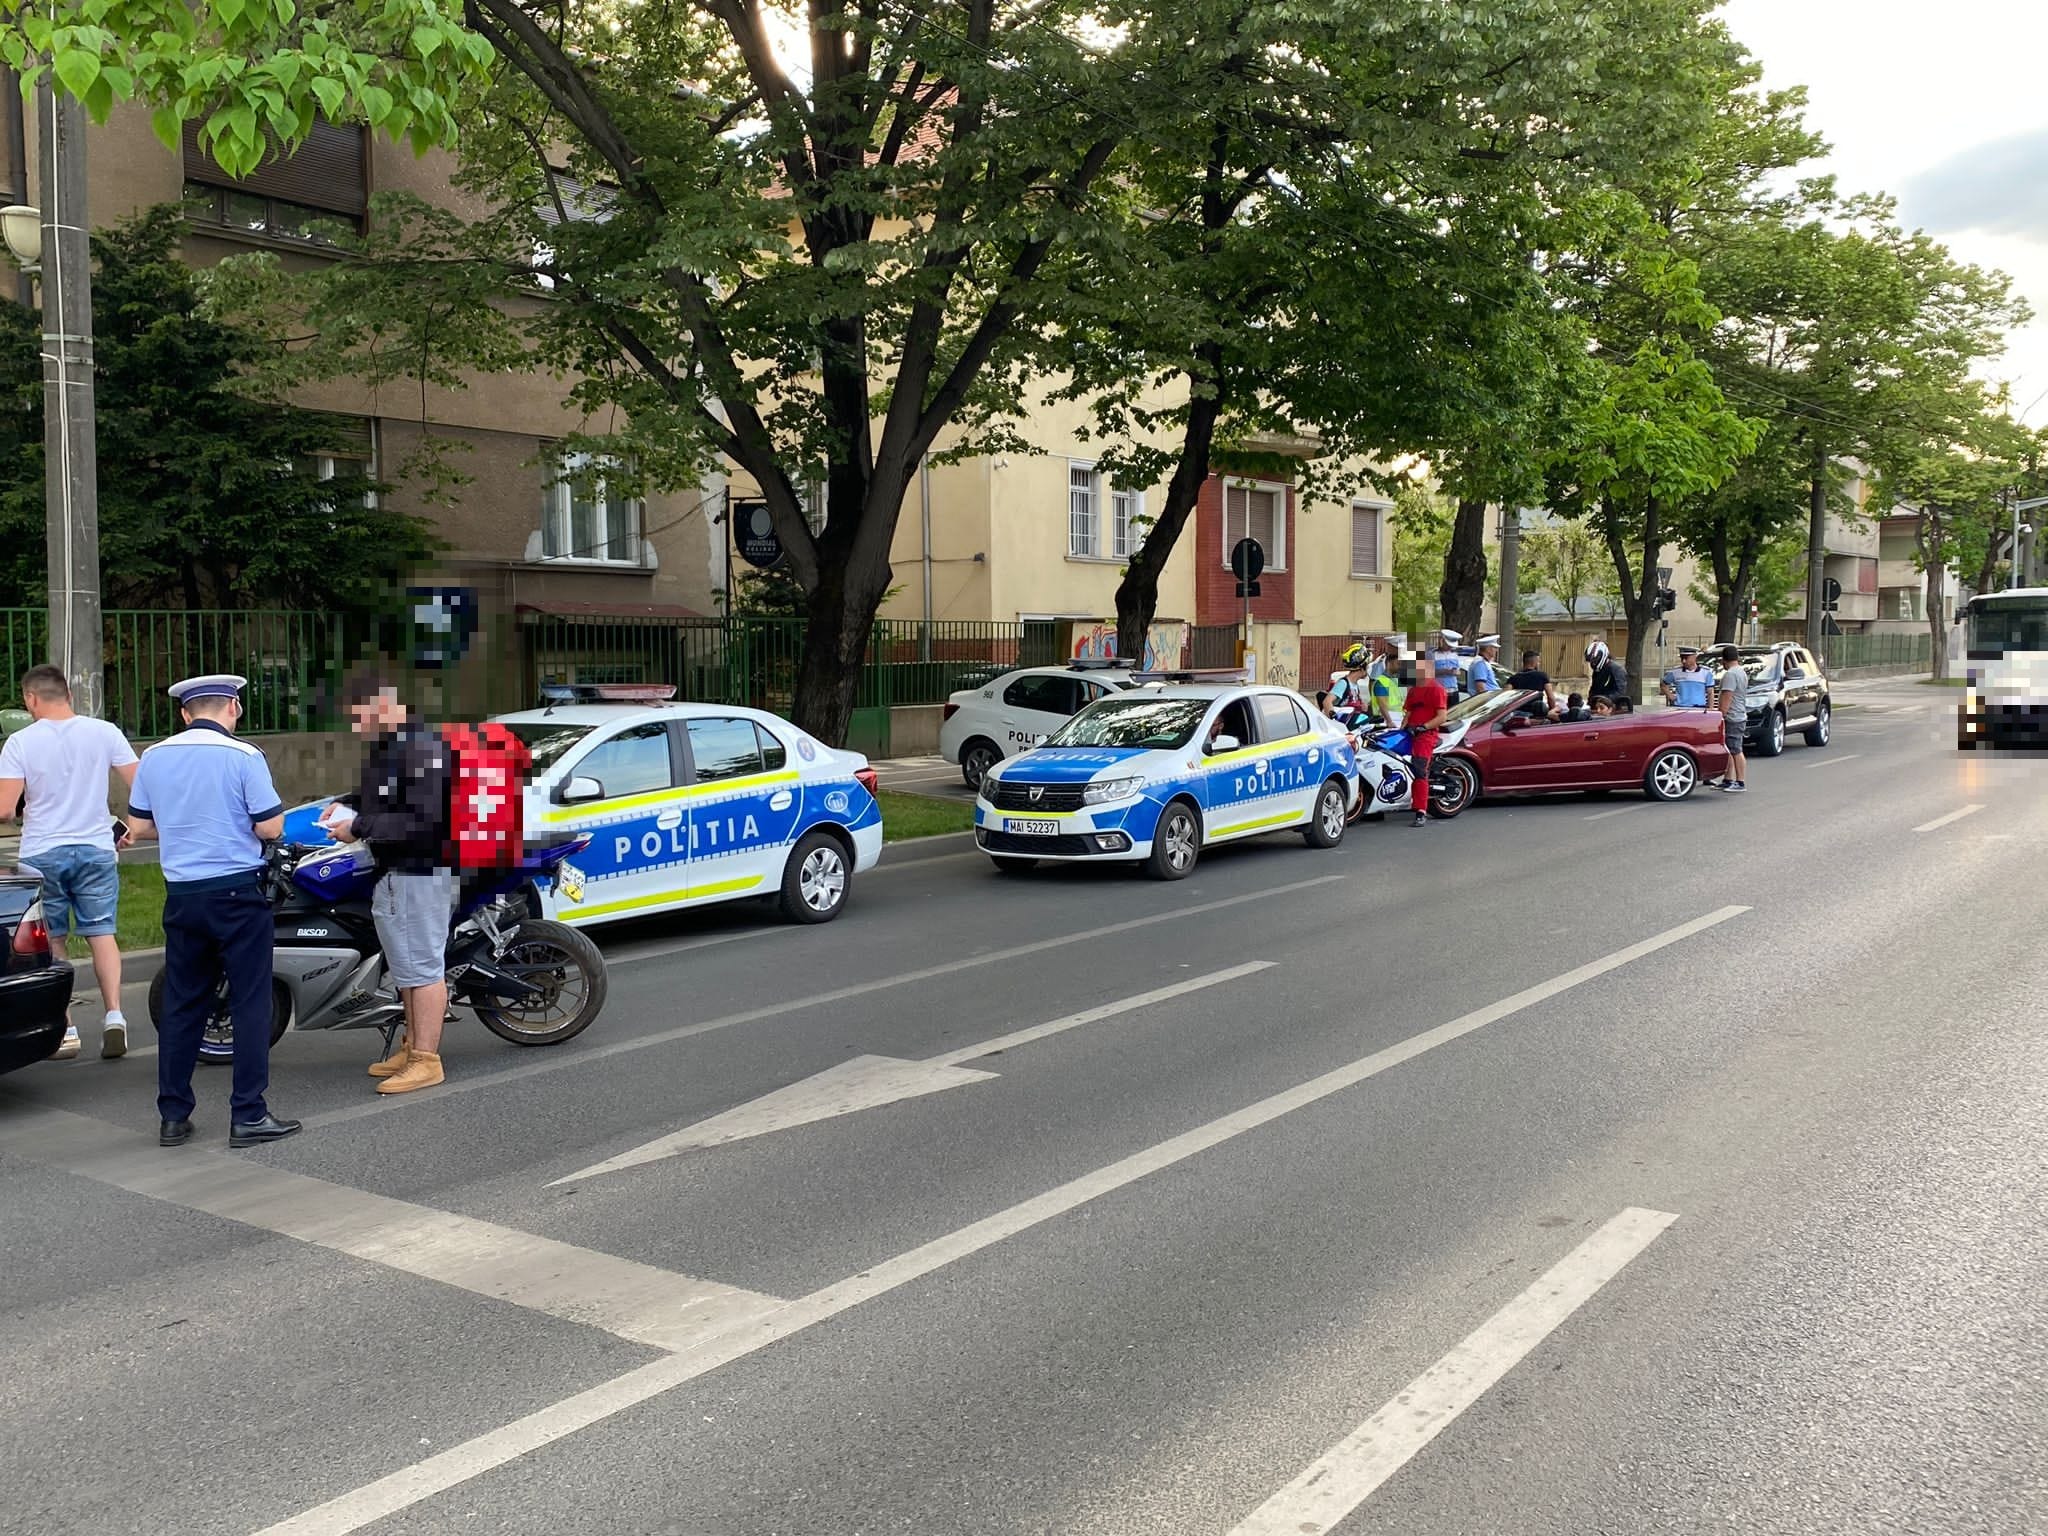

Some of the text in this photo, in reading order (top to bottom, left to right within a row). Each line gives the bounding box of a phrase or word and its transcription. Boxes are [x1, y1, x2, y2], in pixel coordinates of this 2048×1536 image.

[1008, 730, 1044, 745] POLI
[1235, 766, 1304, 797] POLITIA
[615, 815, 760, 863] POLITIA
[1010, 822, 1055, 834] MAI 52237
